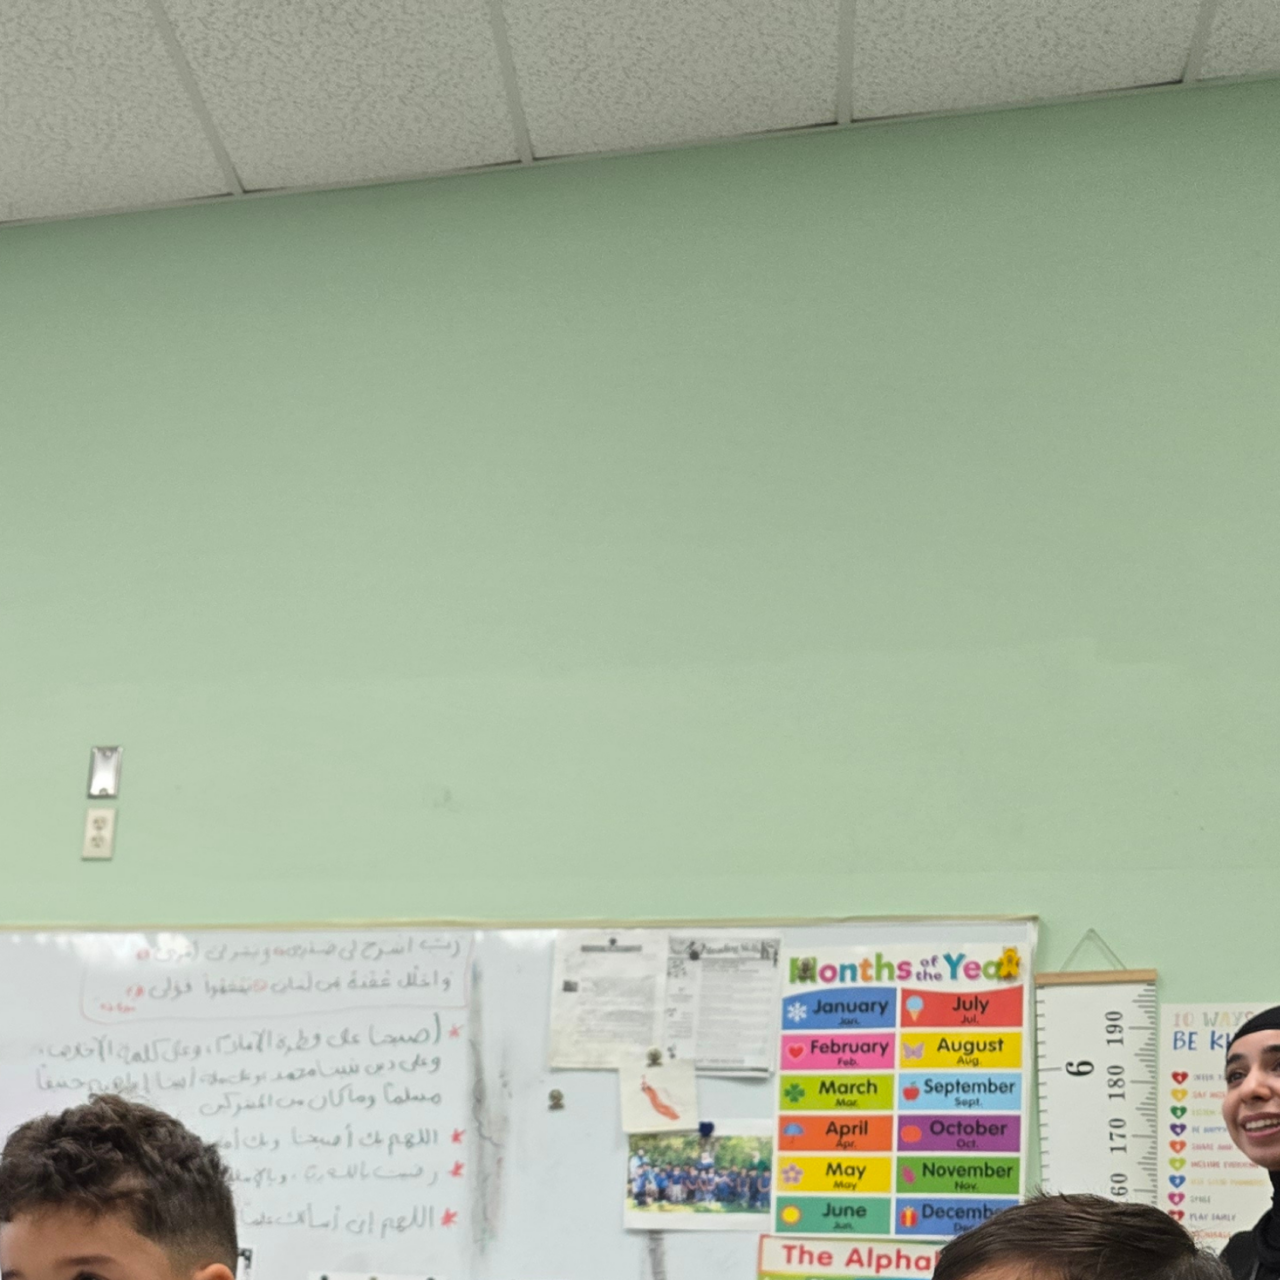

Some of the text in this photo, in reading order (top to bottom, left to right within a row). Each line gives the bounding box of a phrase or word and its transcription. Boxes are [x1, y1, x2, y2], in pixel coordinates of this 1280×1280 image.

[790, 952, 1006, 984] Months of the Yea
[812, 998, 889, 1016] January
[952, 996, 990, 1014] July
[961, 1014, 980, 1025] Jul.
[1104, 1010, 1125, 1048] 190
[810, 1039, 890, 1057] February
[936, 1037, 1005, 1056] August
[1173, 1029, 1233, 1051] BE KI
[837, 1056, 859, 1067] Feb.
[956, 1056, 983, 1068] Aug.
[818, 1078, 878, 1095] March
[923, 1078, 1016, 1099] September
[1106, 1064, 1127, 1101] 180
[954, 1096, 984, 1109] Sept.
[825, 1120, 869, 1139] April
[929, 1119, 1009, 1136] October
[1108, 1117, 1128, 1155] 170
[956, 1139, 980, 1149] Oct.
[825, 1162, 867, 1180] May
[922, 1161, 1014, 1178] November
[833, 1180, 858, 1192] May
[954, 1181, 980, 1191] Nov.
[1110, 1172, 1129, 1200] 60
[822, 1202, 867, 1219] June
[921, 1203, 1003, 1220] Decemb
[781, 1245, 941, 1274] The Alpha
